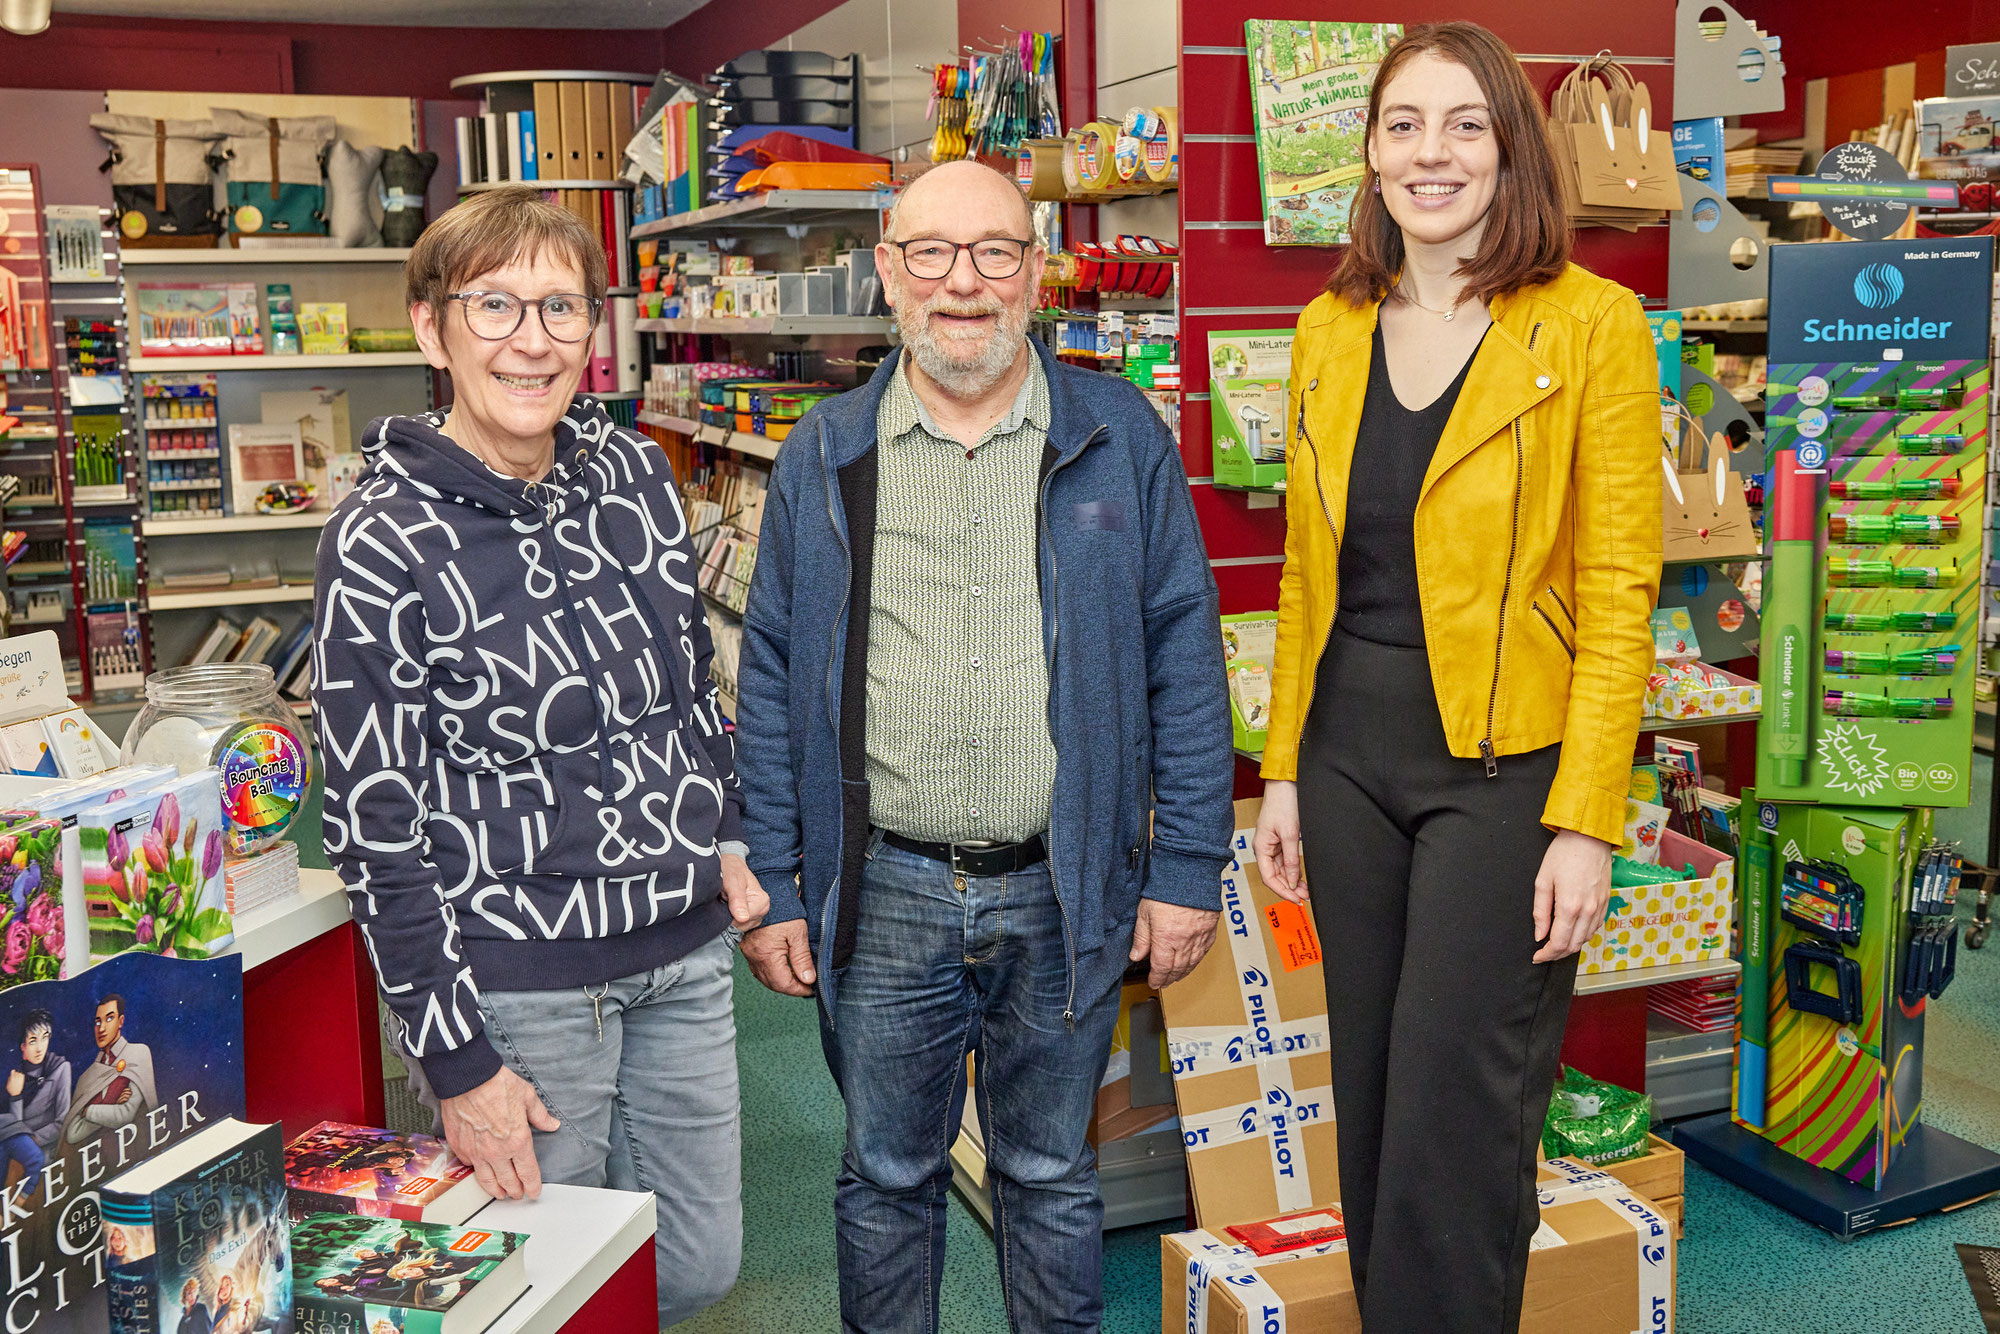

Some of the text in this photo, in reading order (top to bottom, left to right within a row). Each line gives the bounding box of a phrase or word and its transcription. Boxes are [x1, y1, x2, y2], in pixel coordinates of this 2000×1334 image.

[1301, 72, 1359, 93] Mein großes
[1904, 250, 1981, 260] Made in Germany
[1803, 316, 1953, 343] Schneider
[1916, 364, 1946, 373] Fibrepen
[1783, 635, 1795, 687] Schneider
[229, 759, 289, 787] Bouncing
[1833, 735, 1873, 780] CLICK!
[1898, 769, 1918, 779] Bio
[249, 779, 274, 798] Ball
[470, 863, 695, 940] SMITH
[1222, 878, 1248, 938] PILOT
[1610, 919, 1627, 929] DIE
[1751, 911, 1761, 958] Schneider
[1248, 993, 1273, 1055] PILOT
[0, 1090, 206, 1231] KEEPER
[1271, 1114, 1294, 1178] PILOT
[174, 1149, 268, 1217] KEEPER
[67, 1215, 98, 1241] THE
[71, 1204, 91, 1223] OF
[1615, 1197, 1664, 1237] PILOT
[208, 1232, 248, 1265] Das Exil
